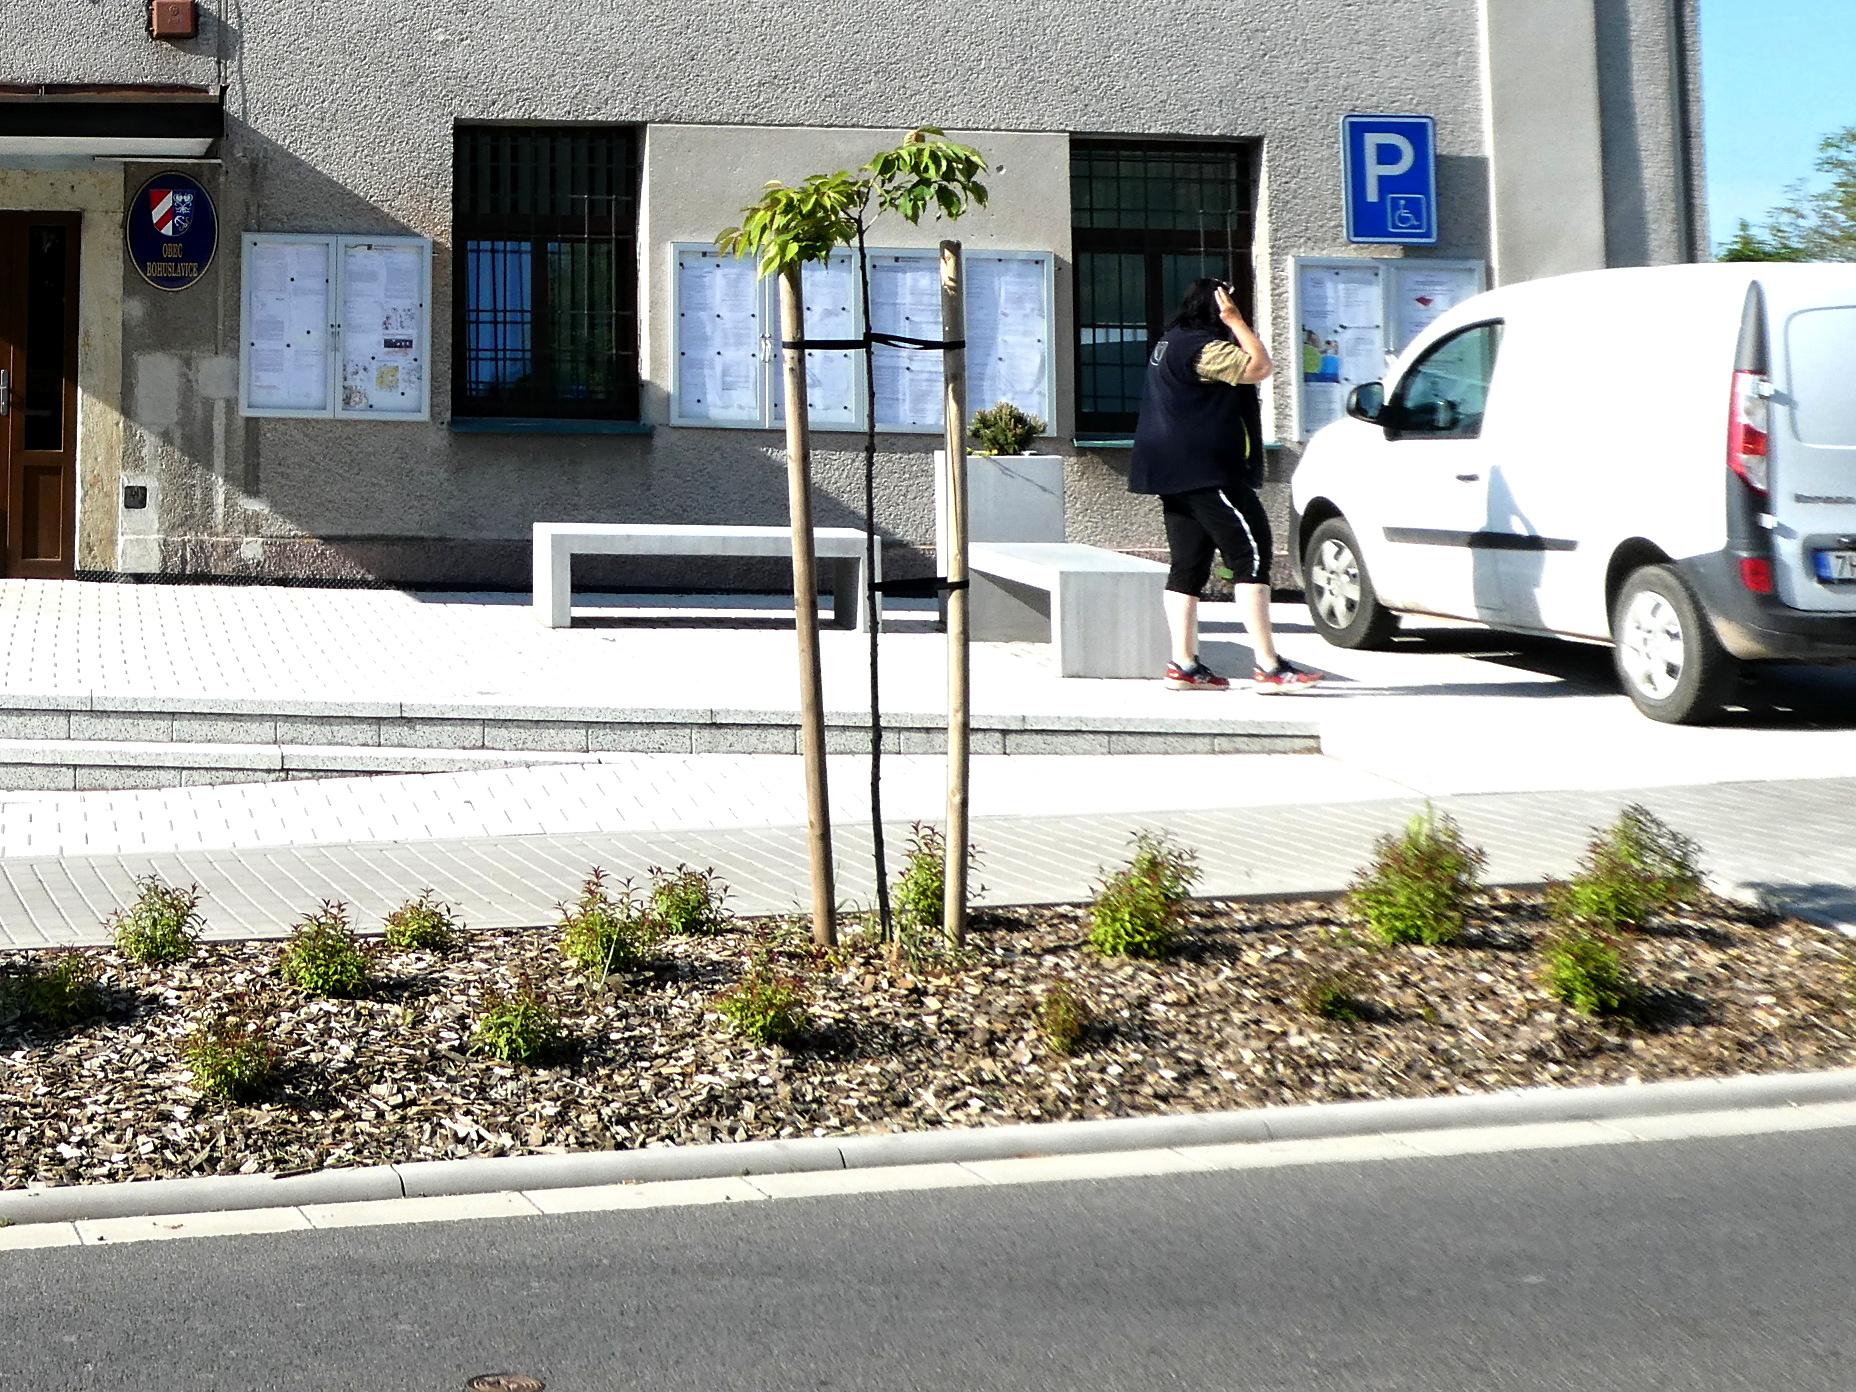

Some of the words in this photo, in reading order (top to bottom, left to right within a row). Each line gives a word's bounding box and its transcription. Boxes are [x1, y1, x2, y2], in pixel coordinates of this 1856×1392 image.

[1363, 132, 1415, 203] P
[162, 243, 183, 258] OBEC
[146, 262, 199, 277] BOHUSLAVICE
